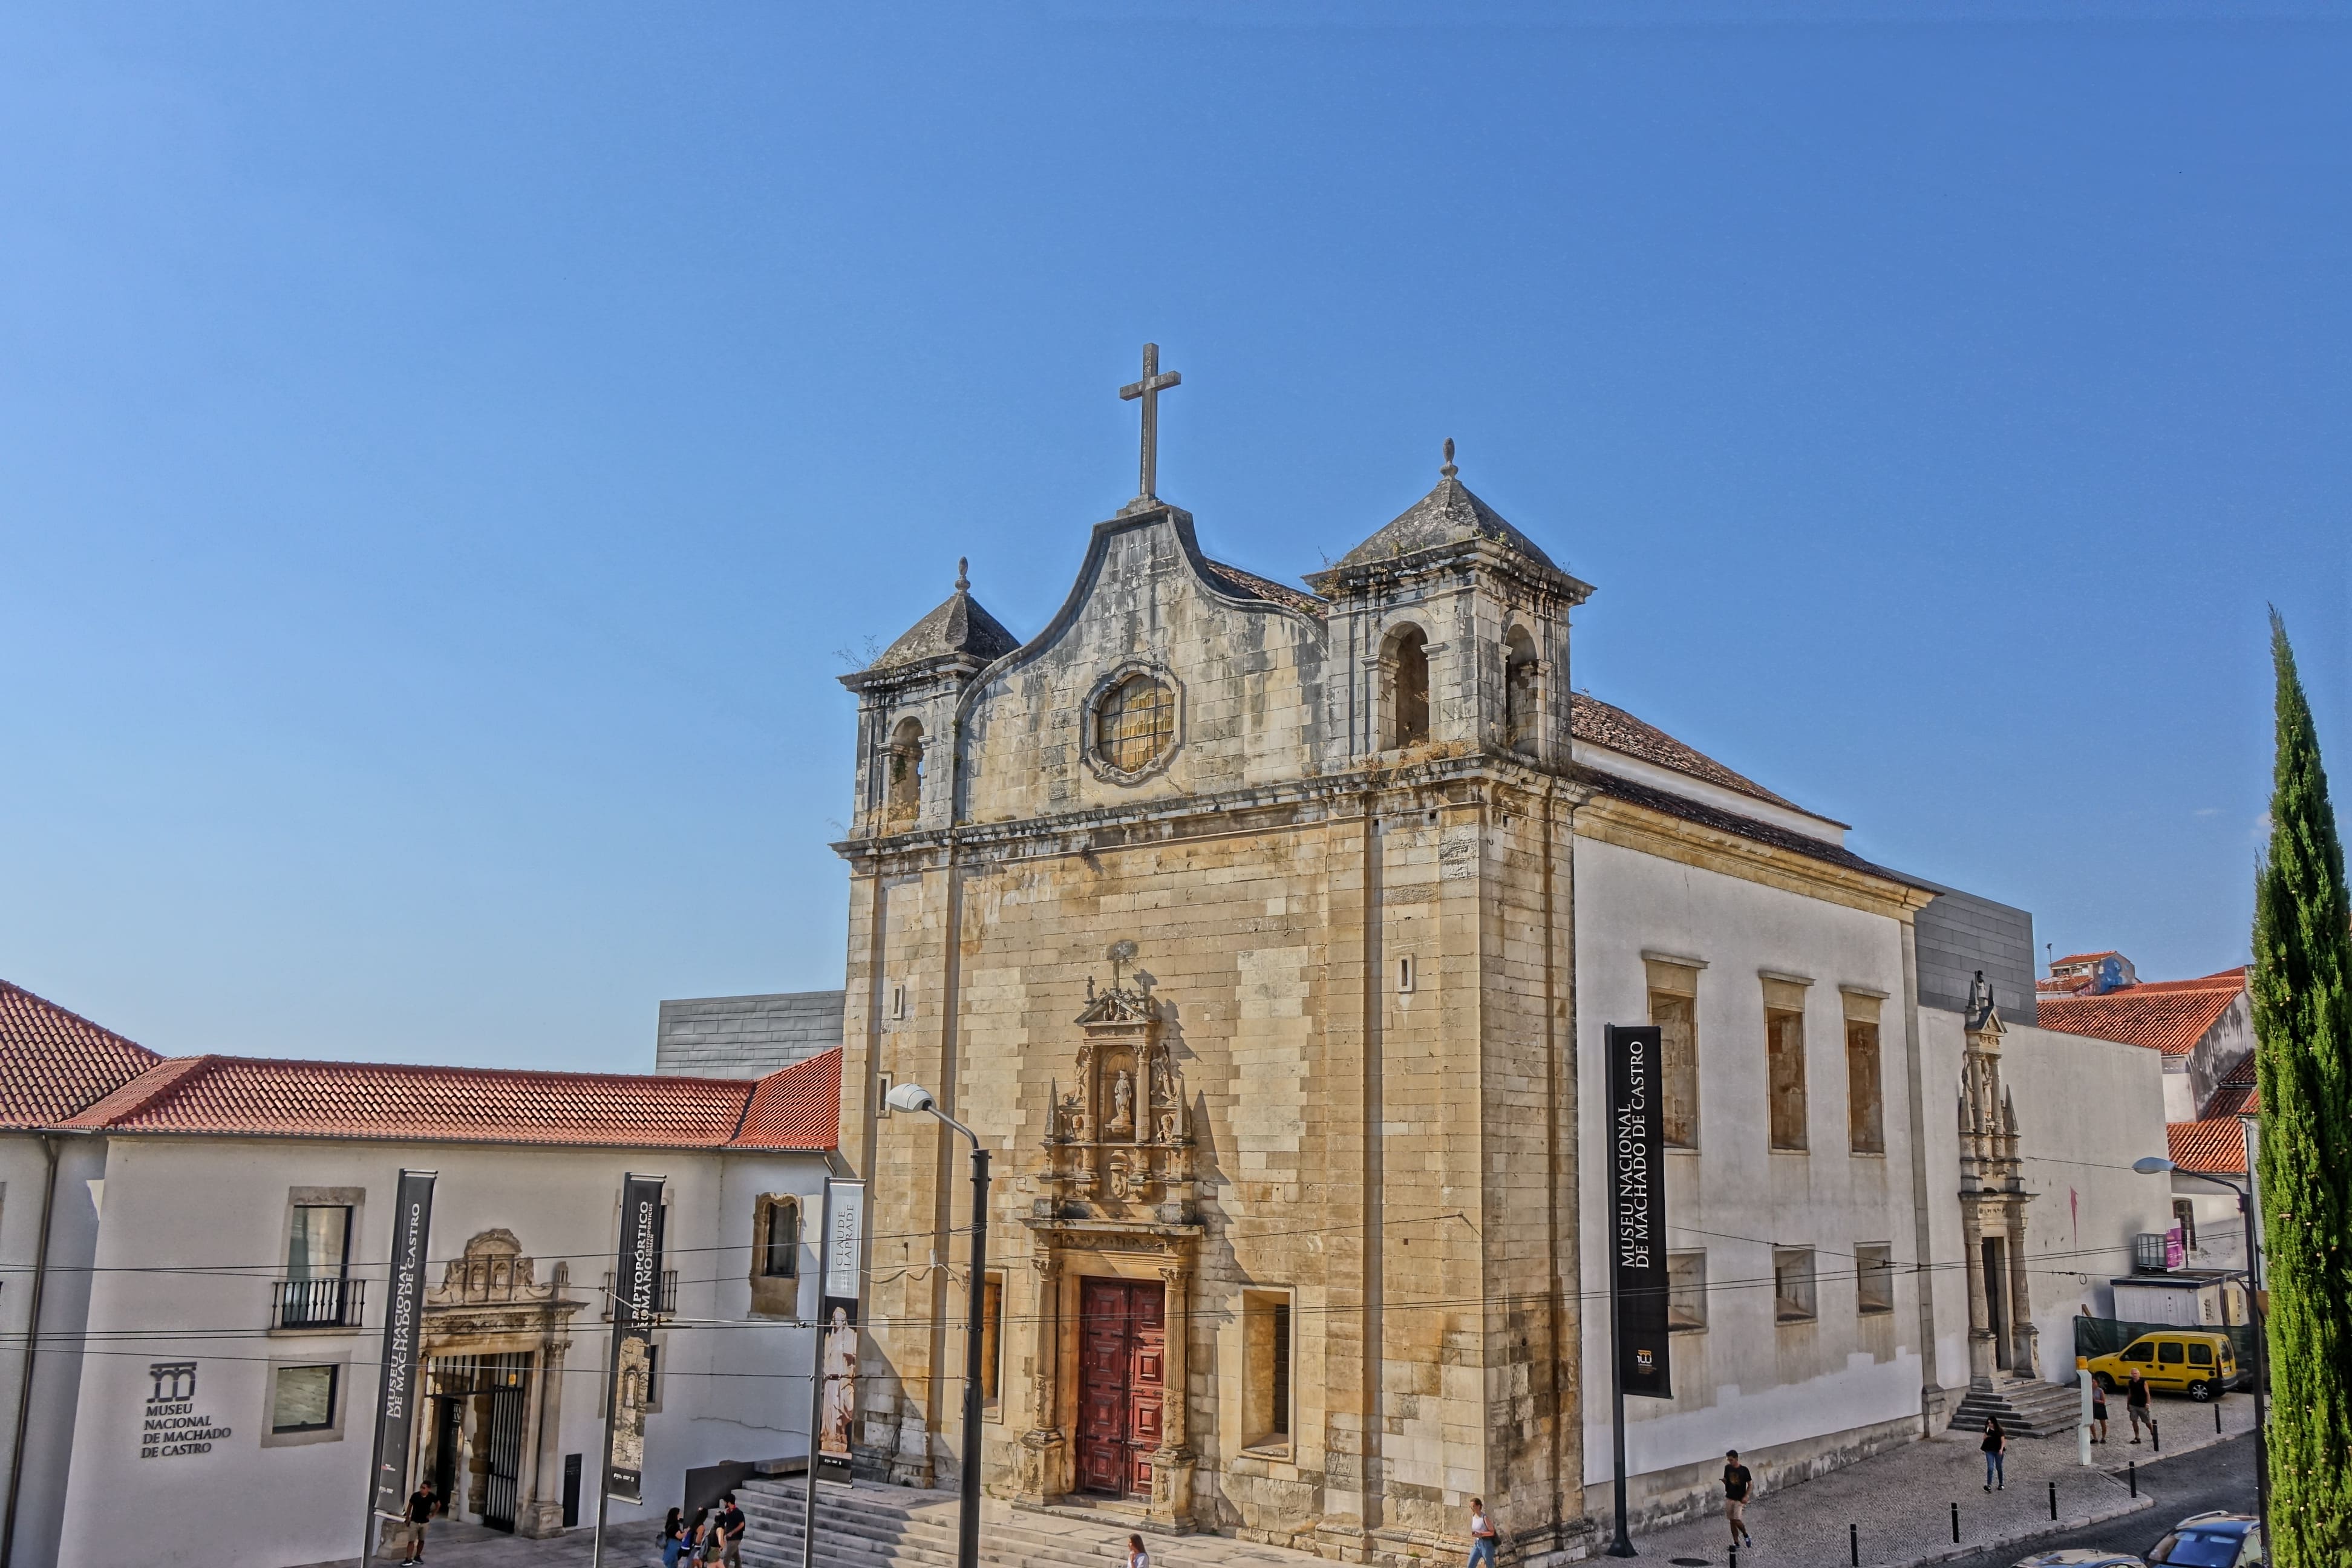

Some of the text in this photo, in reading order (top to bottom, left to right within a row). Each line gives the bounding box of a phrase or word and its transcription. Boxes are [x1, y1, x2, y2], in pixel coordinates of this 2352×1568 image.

[1630, 1041, 1649, 1269] DE MACHADO DE CASTRO
[1618, 1104, 1635, 1268] MUSEU NACIONAL
[836, 1211, 846, 1266] CLAUDE
[844, 1204, 854, 1266] LAPRADE
[387, 1263, 407, 1417] MUSEU NACIONAL
[393, 1203, 420, 1419] DE MACHADO DE CASTRO
[143, 1428, 232, 1445] DE MACHADO
[144, 1416, 212, 1430] NACIONAL
[145, 1403, 193, 1417] MUSEU
[141, 1443, 212, 1458] DE CASTRO
